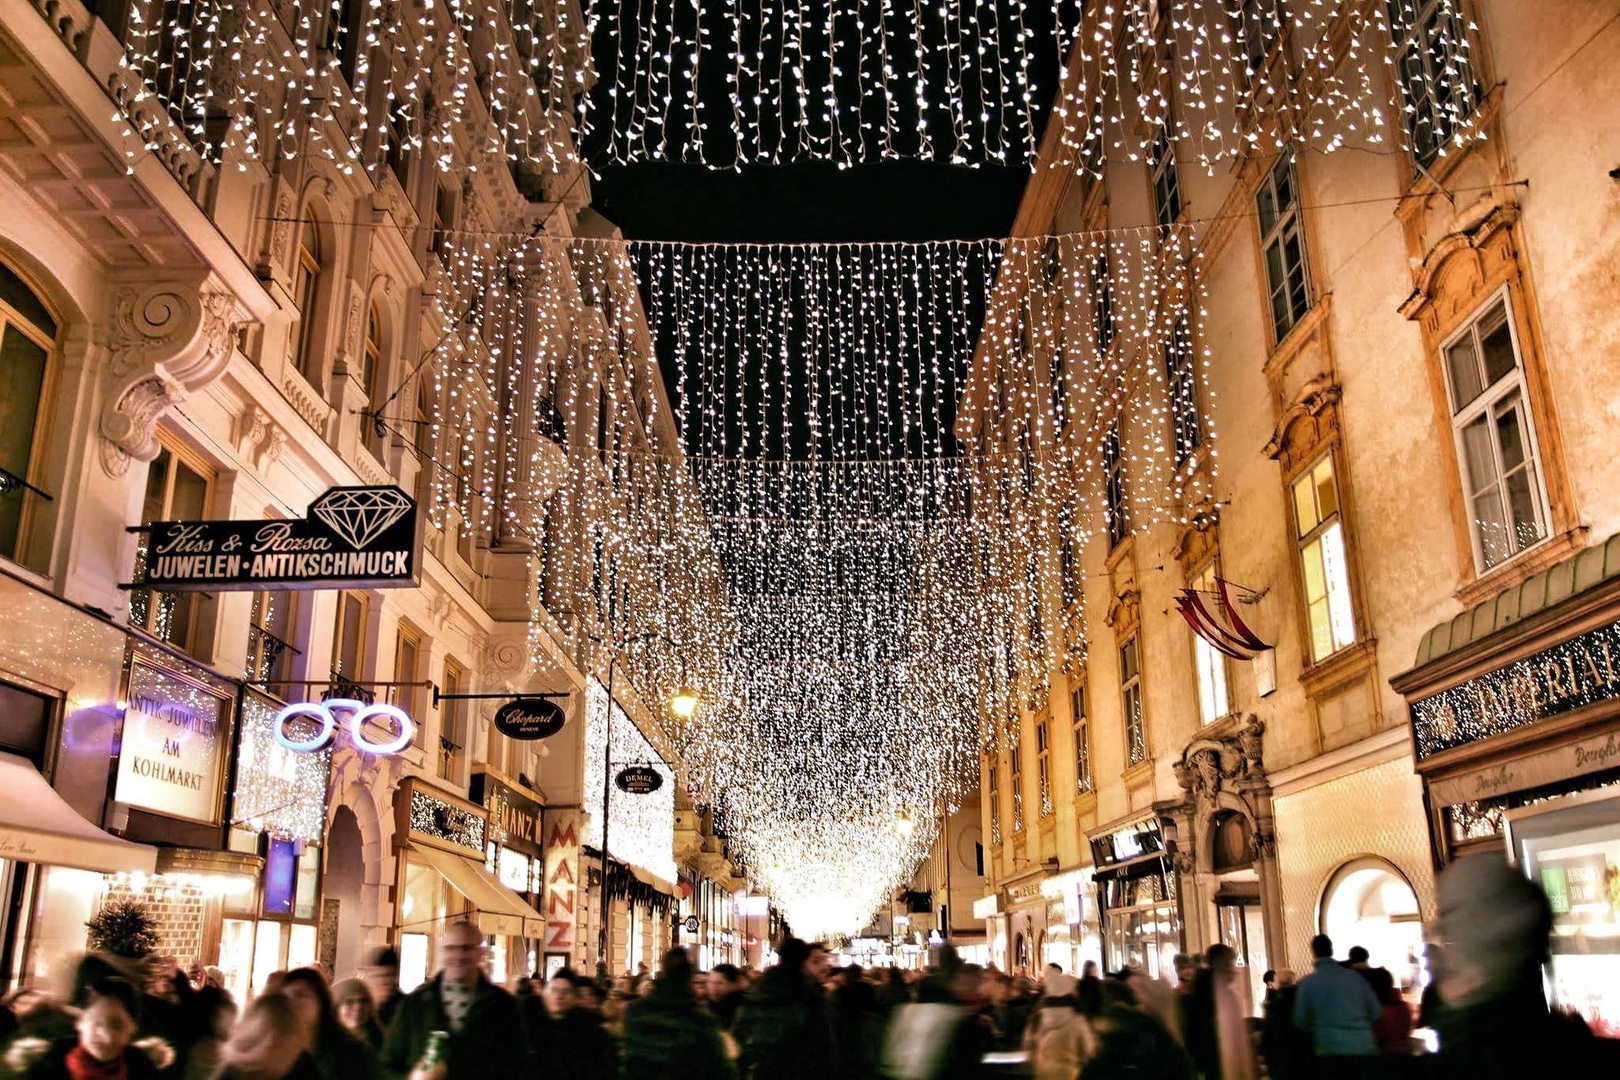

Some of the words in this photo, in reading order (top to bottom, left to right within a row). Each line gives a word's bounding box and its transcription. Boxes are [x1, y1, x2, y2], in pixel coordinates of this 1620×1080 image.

[156, 524, 214, 553] Kiss
[221, 534, 242, 549] &
[150, 554, 240, 579] JUWELEN
[250, 551, 409, 577] ANTIKSCHMUCK
[502, 709, 557, 727] Chopard
[162, 738, 180, 758] AM
[132, 756, 204, 791] KOHLMARKT
[625, 774, 653, 783] DEMEL
[500, 801, 533, 841] MANZ
[548, 822, 577, 947] MANZ
